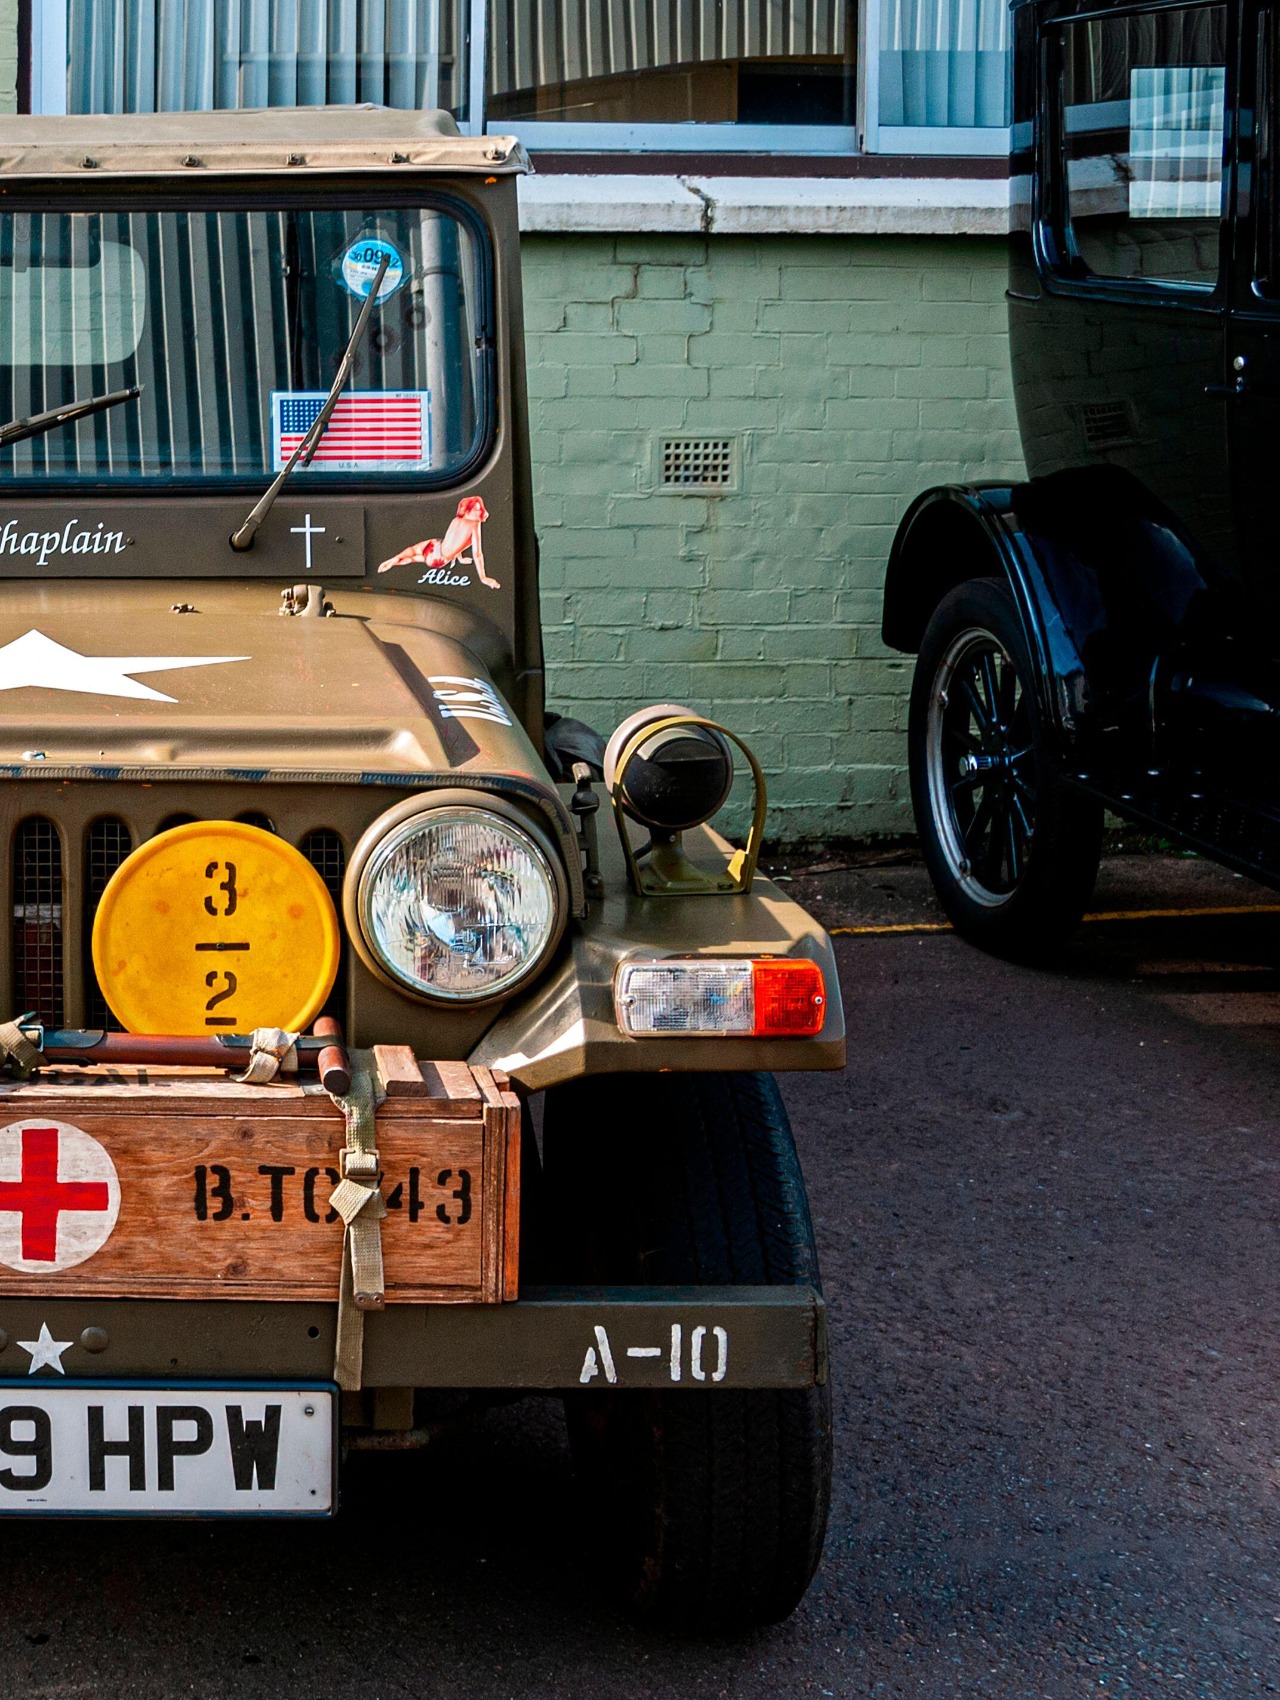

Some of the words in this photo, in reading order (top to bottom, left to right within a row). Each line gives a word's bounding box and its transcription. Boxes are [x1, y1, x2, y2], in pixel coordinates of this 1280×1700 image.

[417, 566, 471, 586] Alice
[203, 861, 238, 917] 3
[204, 970, 238, 1026] 2
[578, 1323, 728, 1384] A-10
[86, 1404, 282, 1492] HPW
